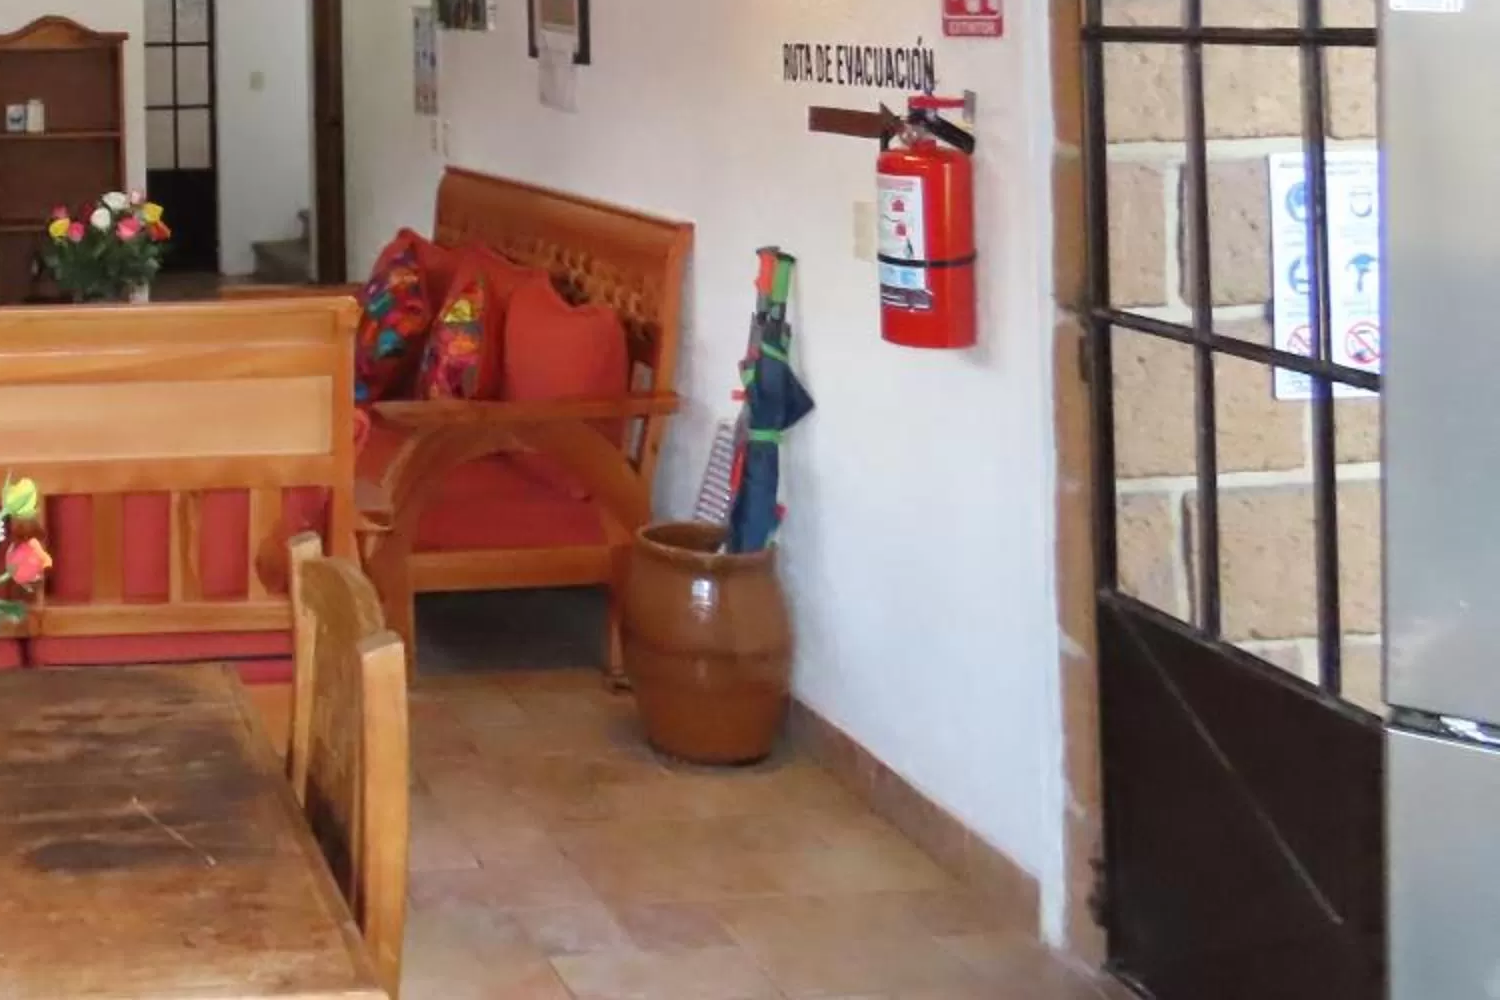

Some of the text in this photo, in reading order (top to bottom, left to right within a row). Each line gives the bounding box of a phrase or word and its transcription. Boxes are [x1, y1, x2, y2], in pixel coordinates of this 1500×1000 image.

[783, 35, 935, 91] RUTA DE EVACUACIÓN
